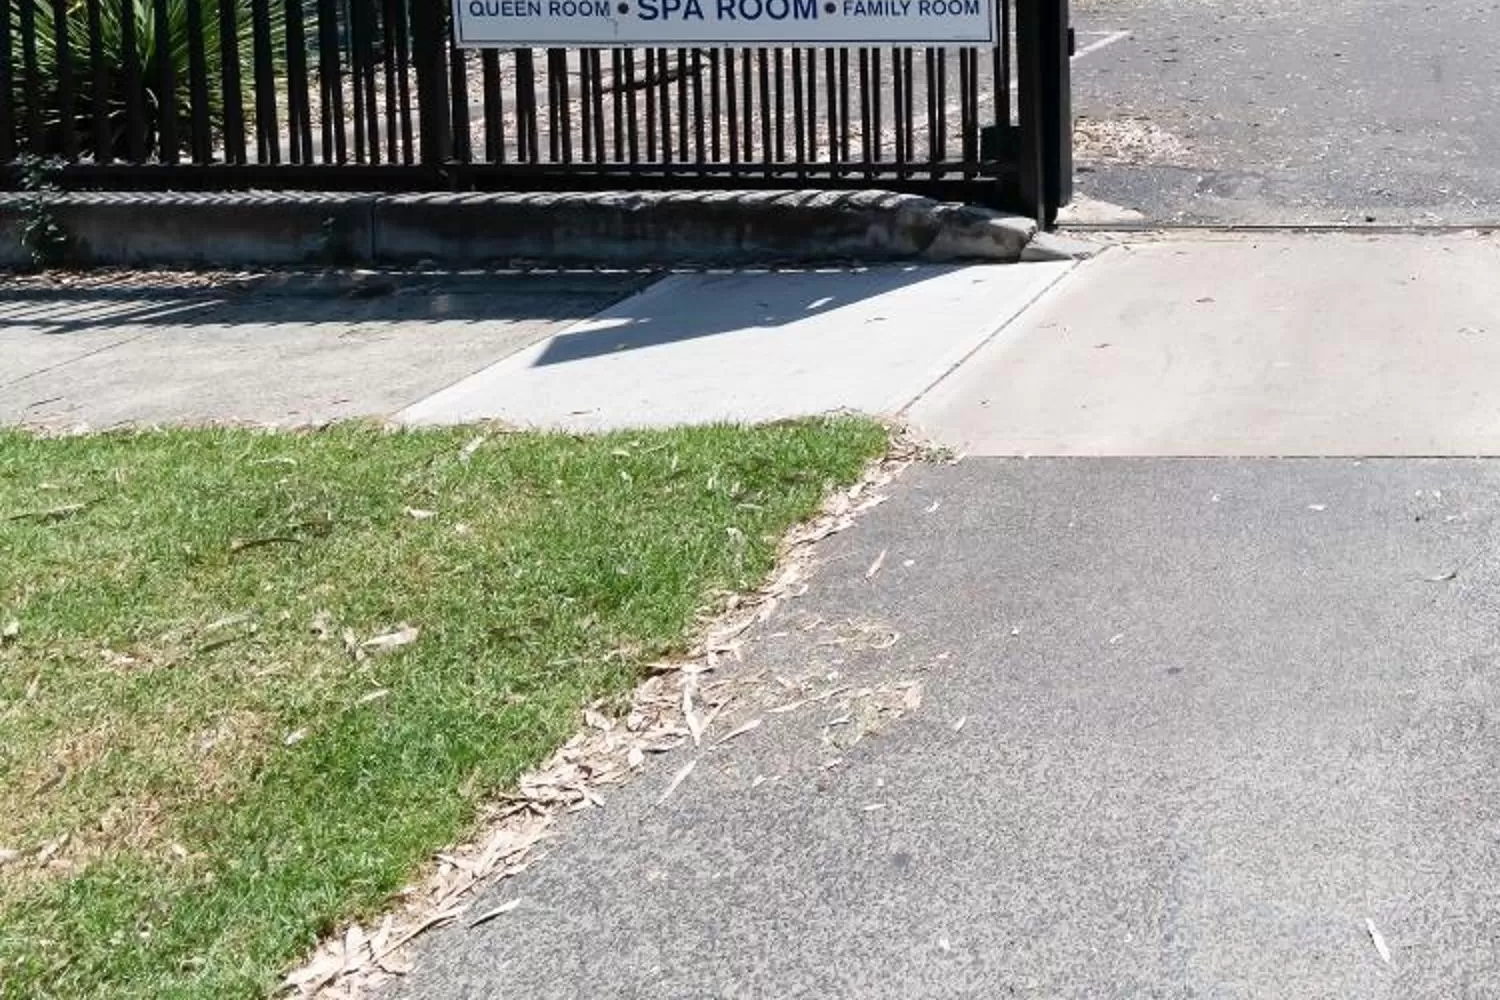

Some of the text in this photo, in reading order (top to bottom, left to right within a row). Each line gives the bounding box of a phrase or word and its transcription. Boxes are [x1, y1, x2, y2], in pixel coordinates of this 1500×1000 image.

[469, 0, 542, 18] QUEEN
[548, 0, 611, 18] ROOM
[843, 0, 911, 17] FAMILY
[917, 0, 980, 17] ROOM
